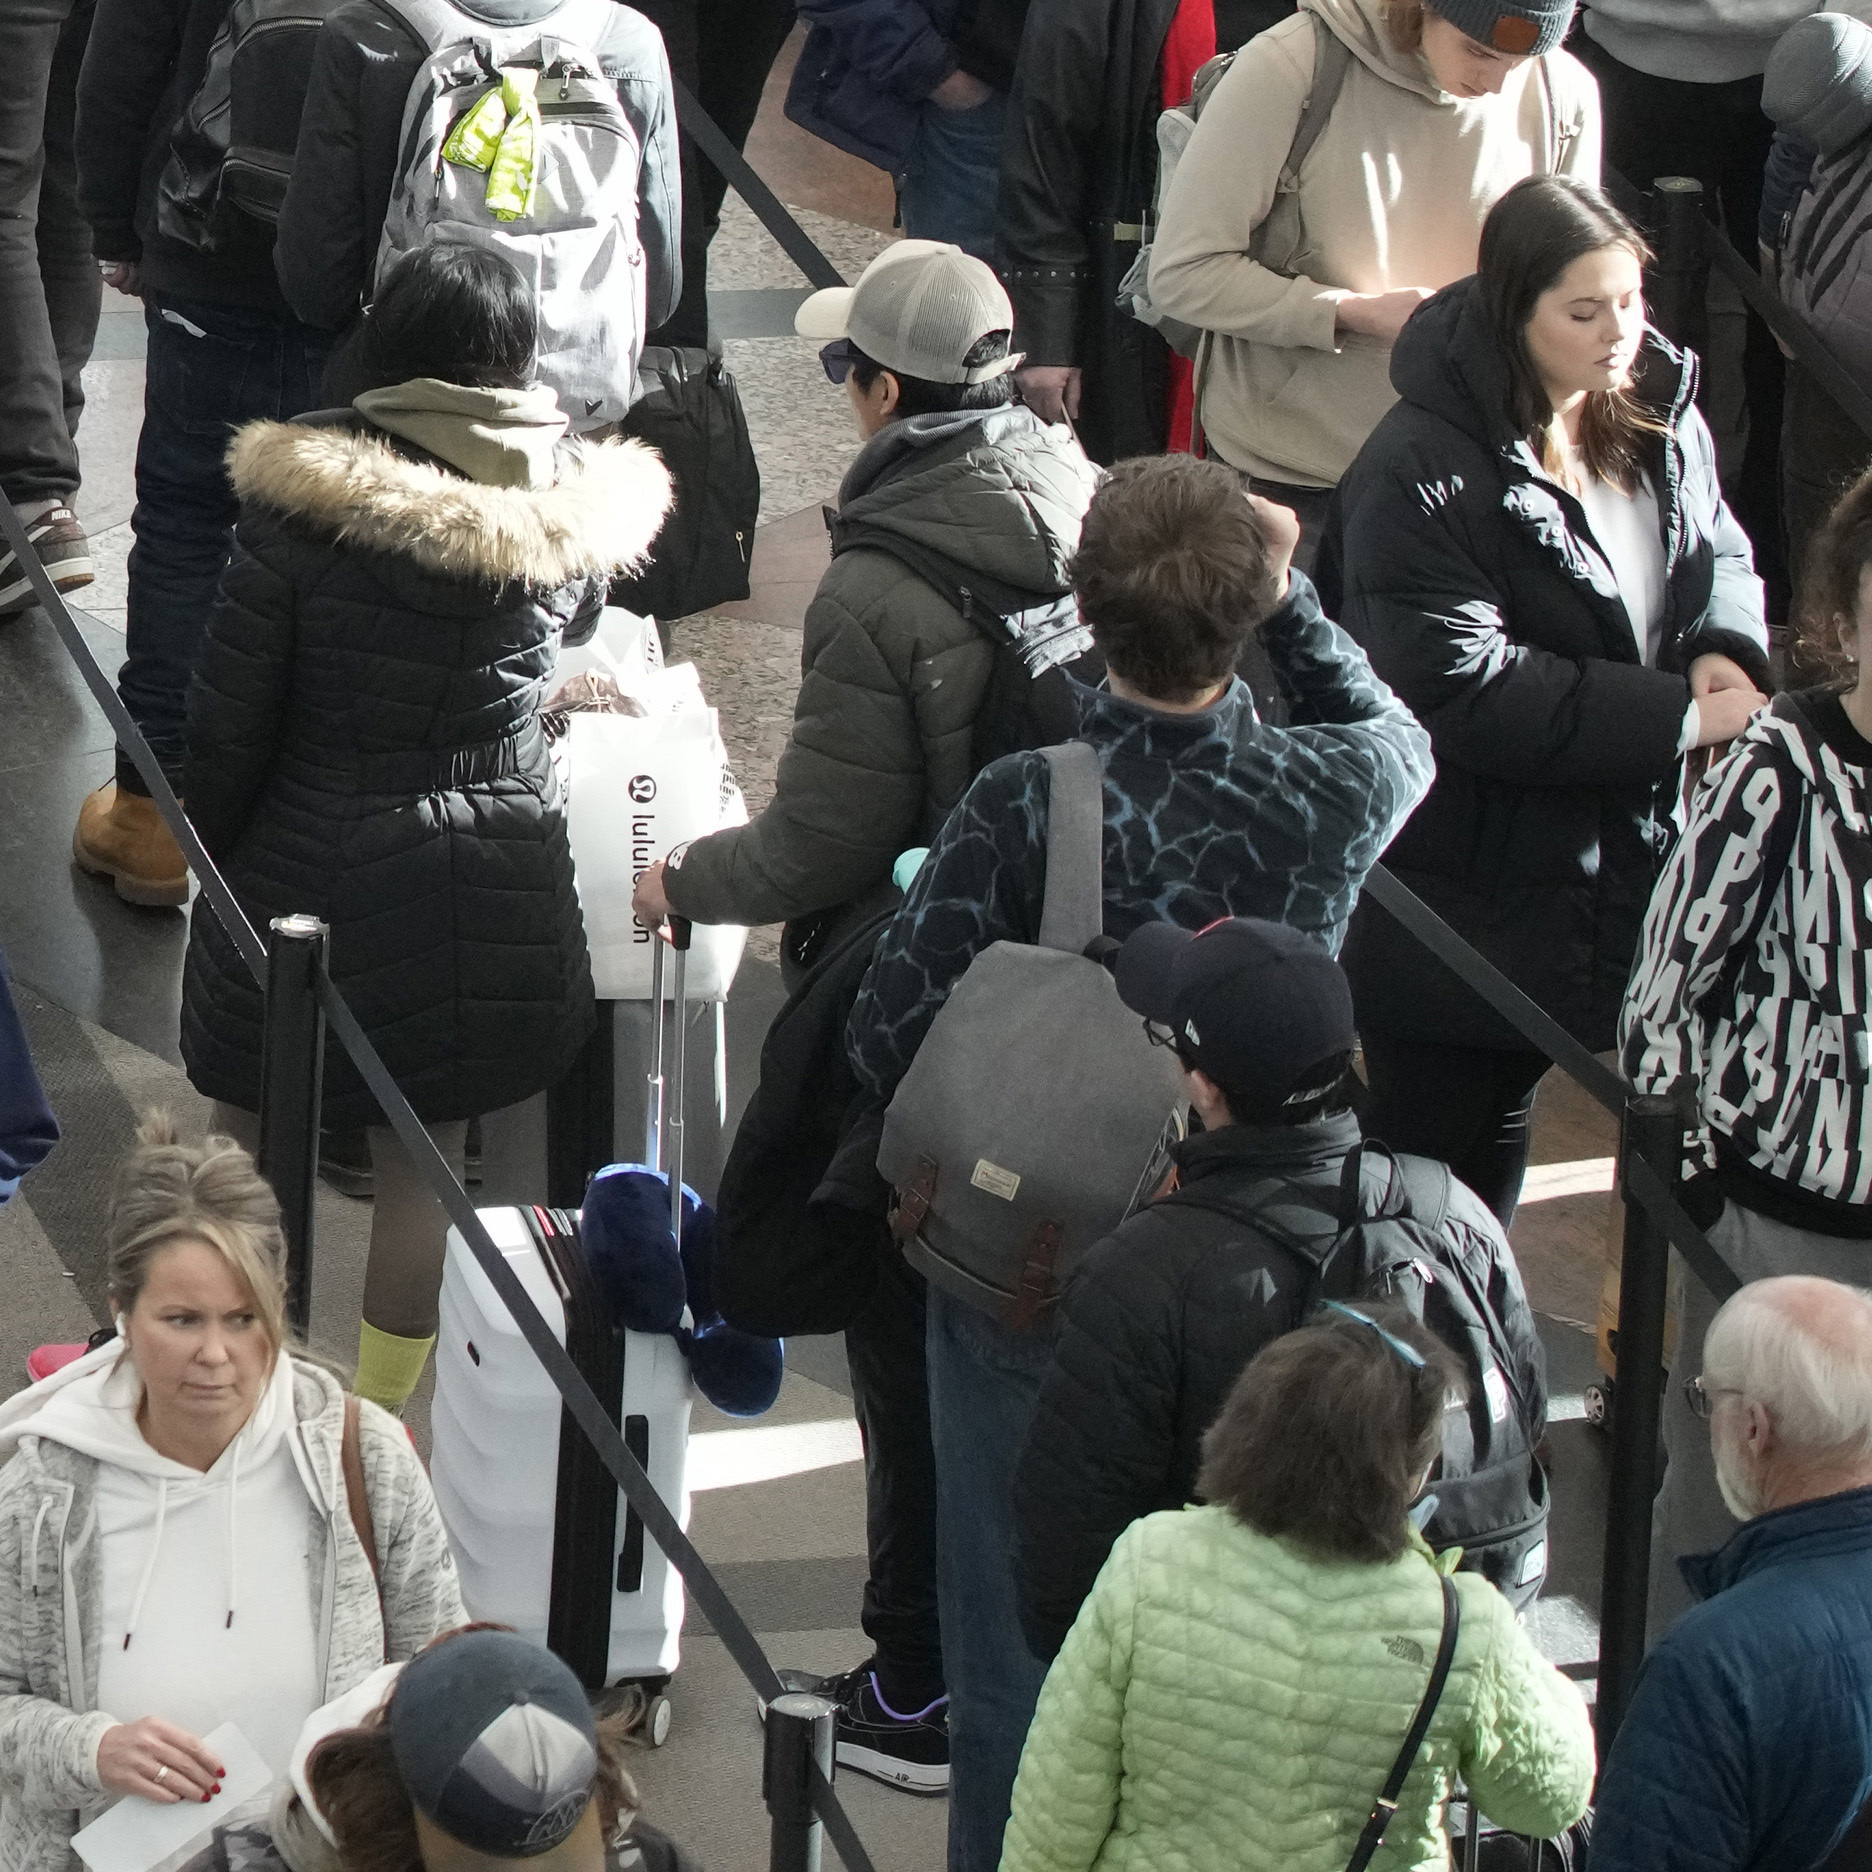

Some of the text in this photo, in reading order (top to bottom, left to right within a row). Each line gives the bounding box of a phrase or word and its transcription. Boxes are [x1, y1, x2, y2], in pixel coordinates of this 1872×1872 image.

[51, 509, 72, 521] NIKE
[632, 815, 656, 945] lululn
[895, 1772, 910, 1784] AIR
